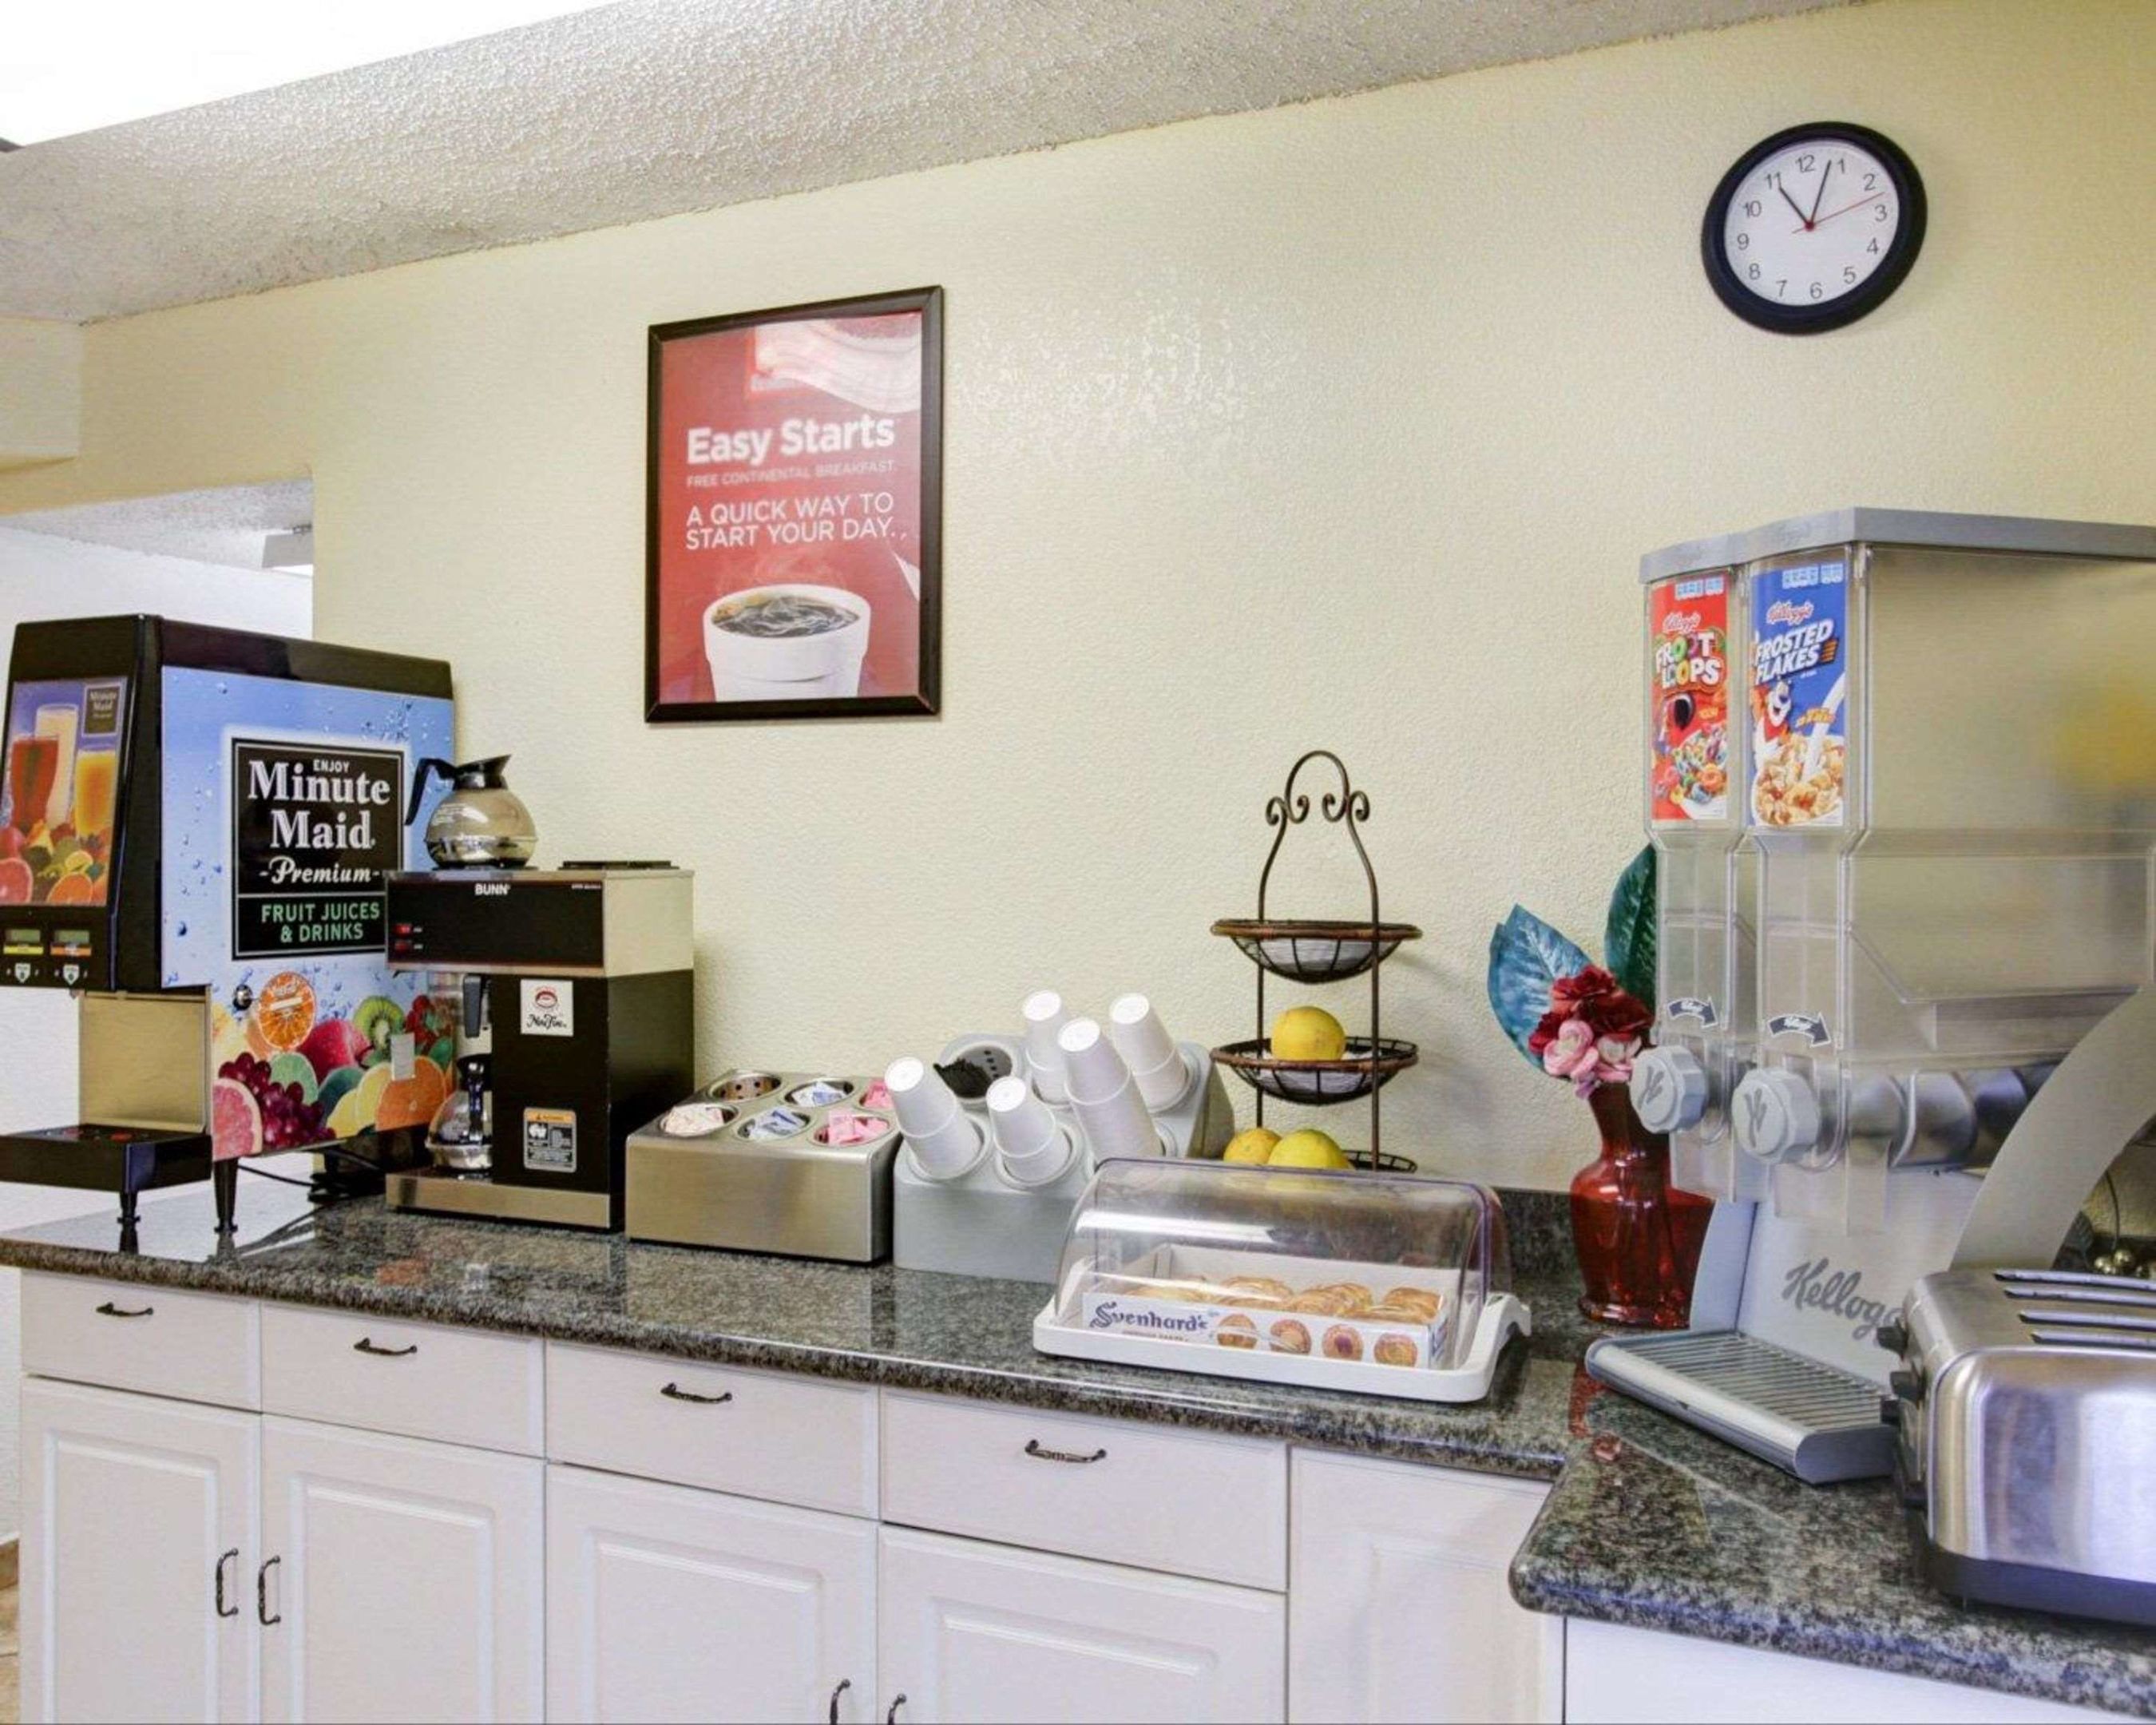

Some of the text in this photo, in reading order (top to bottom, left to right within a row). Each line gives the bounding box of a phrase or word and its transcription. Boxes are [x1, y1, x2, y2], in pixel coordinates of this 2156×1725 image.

[1796, 154, 1816, 173] 12
[1837, 158, 1845, 174] 1
[1764, 172, 1782, 189] 11
[1863, 173, 1877, 192] 2
[1743, 200, 1762, 217] 10
[1874, 204, 1888, 222] 3
[1737, 232, 1750, 251] 9
[1865, 237, 1878, 255] 4
[1749, 263, 1762, 280] 8
[1843, 266, 1857, 284] 5
[1776, 280, 1788, 297] 7
[1809, 282, 1823, 299] 6
[687, 414, 895, 466] Easy Starts
[687, 474, 717, 488] FREE
[686, 492, 894, 526] A QUICK WAY TO
[686, 525, 758, 550] START
[767, 519, 834, 544] YOUR
[1757, 619, 1834, 663] FROSTED
[1756, 644, 1821, 685] FLAKES
[313, 759, 350, 772] ENJOY
[248, 760, 390, 805] Minute
[270, 810, 373, 849] Maid
[474, 882, 509, 896] BUNN
[261, 902, 380, 922] FRUIT JUICES
[280, 923, 363, 943] & DRINKS
[1089, 1301, 1208, 1331] Svenhard's
